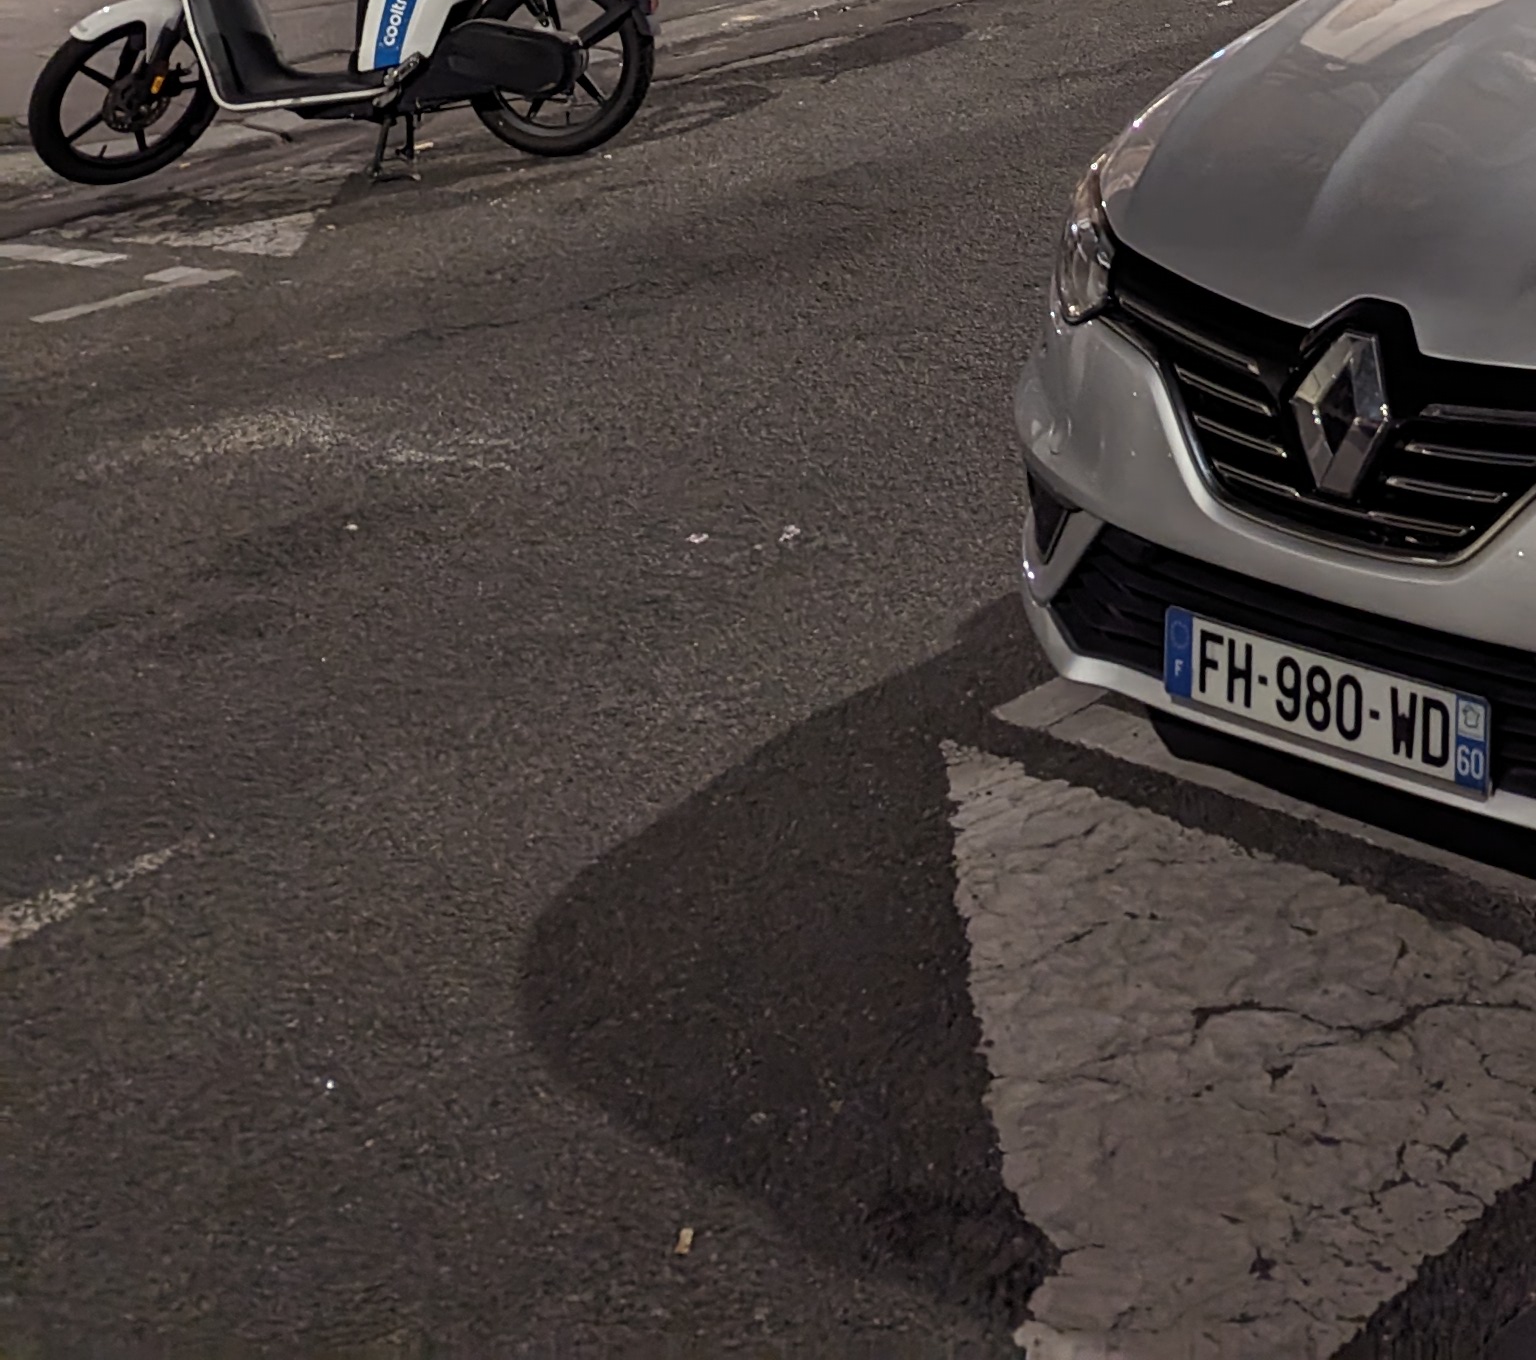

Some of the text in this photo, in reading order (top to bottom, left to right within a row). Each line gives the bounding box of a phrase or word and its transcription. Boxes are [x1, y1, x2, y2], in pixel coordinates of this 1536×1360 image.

[1174, 659, 1184, 677] F
[1199, 628, 1450, 769] FH-980-WD
[1456, 747, 1485, 780] 60
